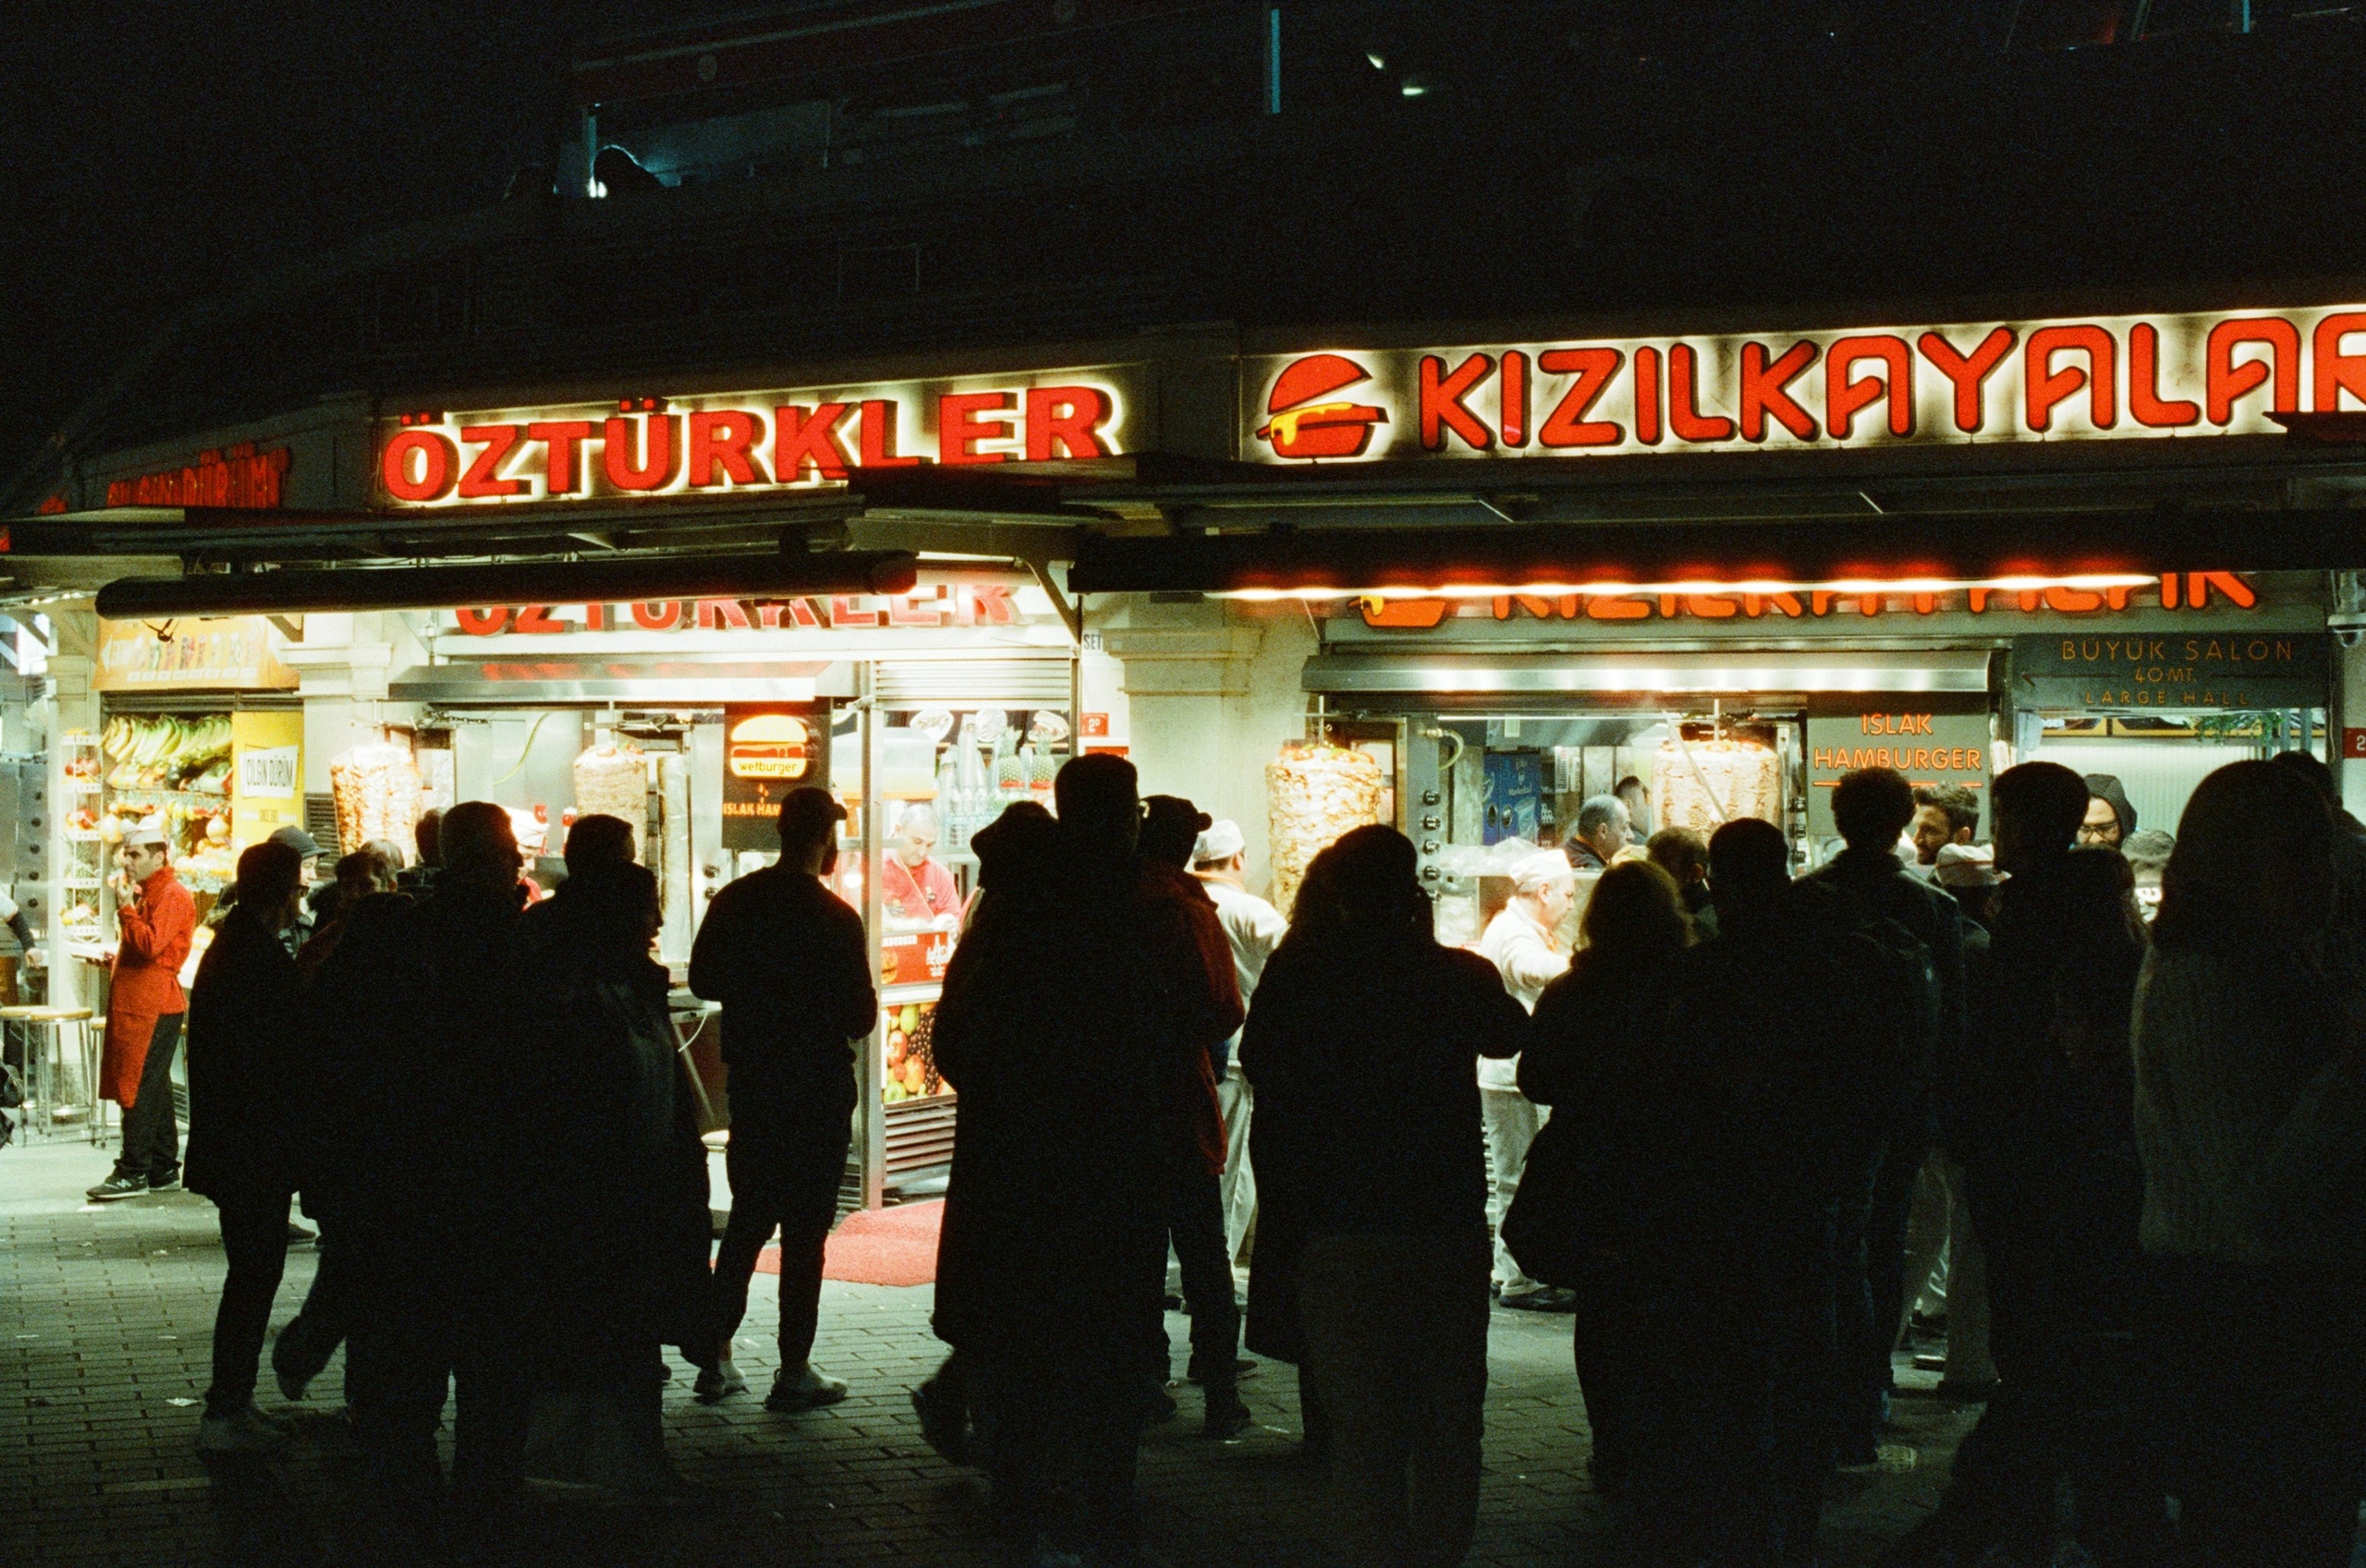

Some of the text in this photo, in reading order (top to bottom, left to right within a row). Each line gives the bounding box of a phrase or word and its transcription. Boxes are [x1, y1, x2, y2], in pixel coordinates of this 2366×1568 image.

[1419, 312, 2366, 451] KIZILKAYALAR
[384, 385, 1102, 502] ÖZTÜRKLER
[2061, 638, 2292, 662] BÜYÜK SALON
[2085, 690, 2250, 706] LARGE HALL
[1861, 713, 1933, 735] ISLAK
[739, 760, 798, 775] wetburger
[1813, 747, 1982, 771] HAMBURGER
[723, 803, 755, 816] ISLAK
